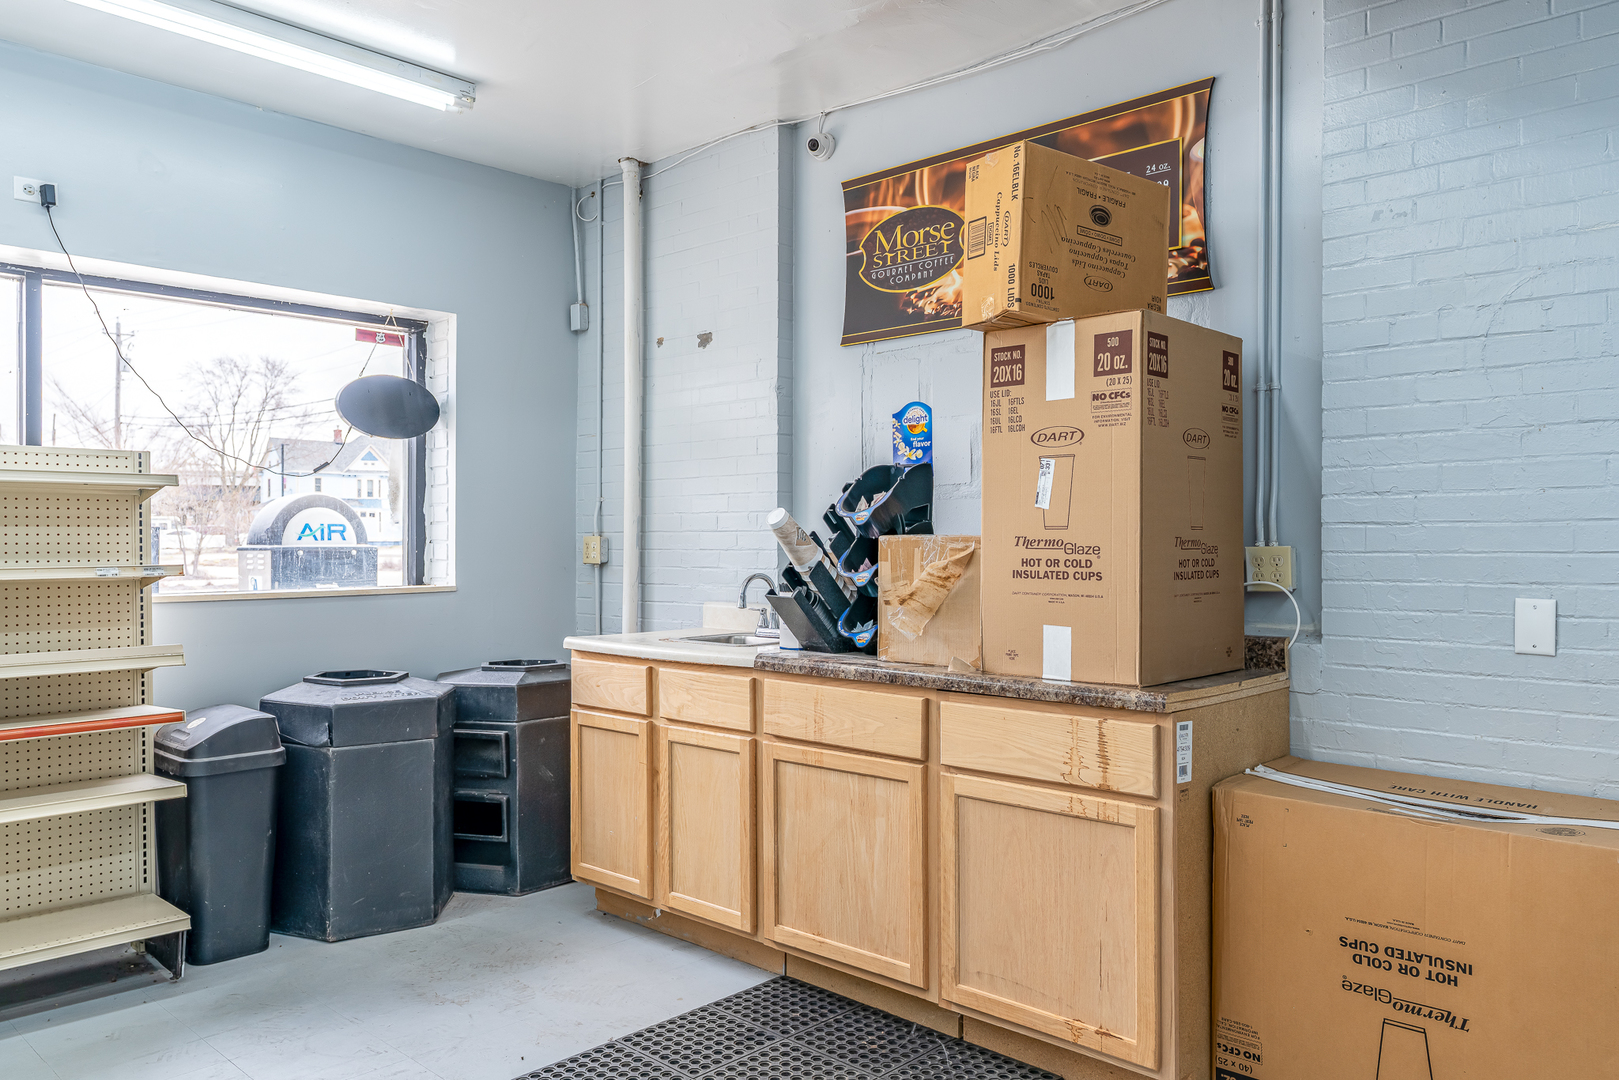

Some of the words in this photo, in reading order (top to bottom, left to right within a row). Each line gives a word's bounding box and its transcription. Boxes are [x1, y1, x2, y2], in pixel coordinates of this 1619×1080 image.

[1146, 164, 1156, 173] 24
[1076, 187, 1097, 200] FRAGIL
[1102, 194, 1126, 208] FRAGILE
[994, 192, 1003, 248] Cappuccino
[873, 222, 955, 255] Morse
[1061, 236, 1101, 253] Cappuccino
[873, 240, 953, 268] STREET
[1069, 248, 1108, 265] Cappuccino
[1103, 247, 1136, 262] Couvercles
[872, 264, 913, 279] GOURMET
[918, 256, 954, 270] COFFEE
[1072, 258, 1086, 269] Lids
[1109, 258, 1128, 270] Tapas
[890, 270, 933, 284] COMPANY
[1088, 263, 1125, 278] Cappuccino
[1031, 282, 1054, 300] 1000
[1088, 279, 1110, 290] DART
[1107, 337, 1119, 347] 500
[994, 352, 1011, 361] STOCK
[1012, 350, 1022, 359] NO.
[1097, 352, 1110, 371] 20
[1149, 352, 1167, 373] 20X16
[993, 364, 1022, 383] 20X16
[1224, 369, 1230, 386] 20
[990, 390, 1000, 398] USE
[1092, 393, 1107, 401] NO
[1108, 391, 1130, 400] CFCs
[903, 414, 928, 424] delight
[1037, 431, 1077, 442] DART
[1186, 433, 1207, 444] DART
[1021, 558, 1042, 567] HOT
[1046, 559, 1060, 568] OR
[1064, 559, 1092, 568] COLD
[1179, 559, 1190, 568] HOT
[1192, 559, 1199, 568] OR
[1201, 558, 1215, 567] COLD
[1012, 570, 1069, 580] INSULATED
[1073, 571, 1103, 581] CUPS
[1174, 570, 1204, 580] INSULATED
[1206, 570, 1219, 578] CUPS
[1388, 785, 1426, 794] CARE
[1430, 791, 1469, 801] WITH
[1474, 797, 1538, 810] HANDLE
[1339, 936, 1379, 954] CUPS
[1352, 953, 1392, 971] COLD
[1384, 946, 1473, 976] INSULATED
[1398, 963, 1420, 977] OR
[1425, 970, 1458, 987] HOT
[1217, 1042, 1241, 1056] CFCs
[1243, 1051, 1260, 1062] NO
[1239, 1063, 1252, 1074] (40
